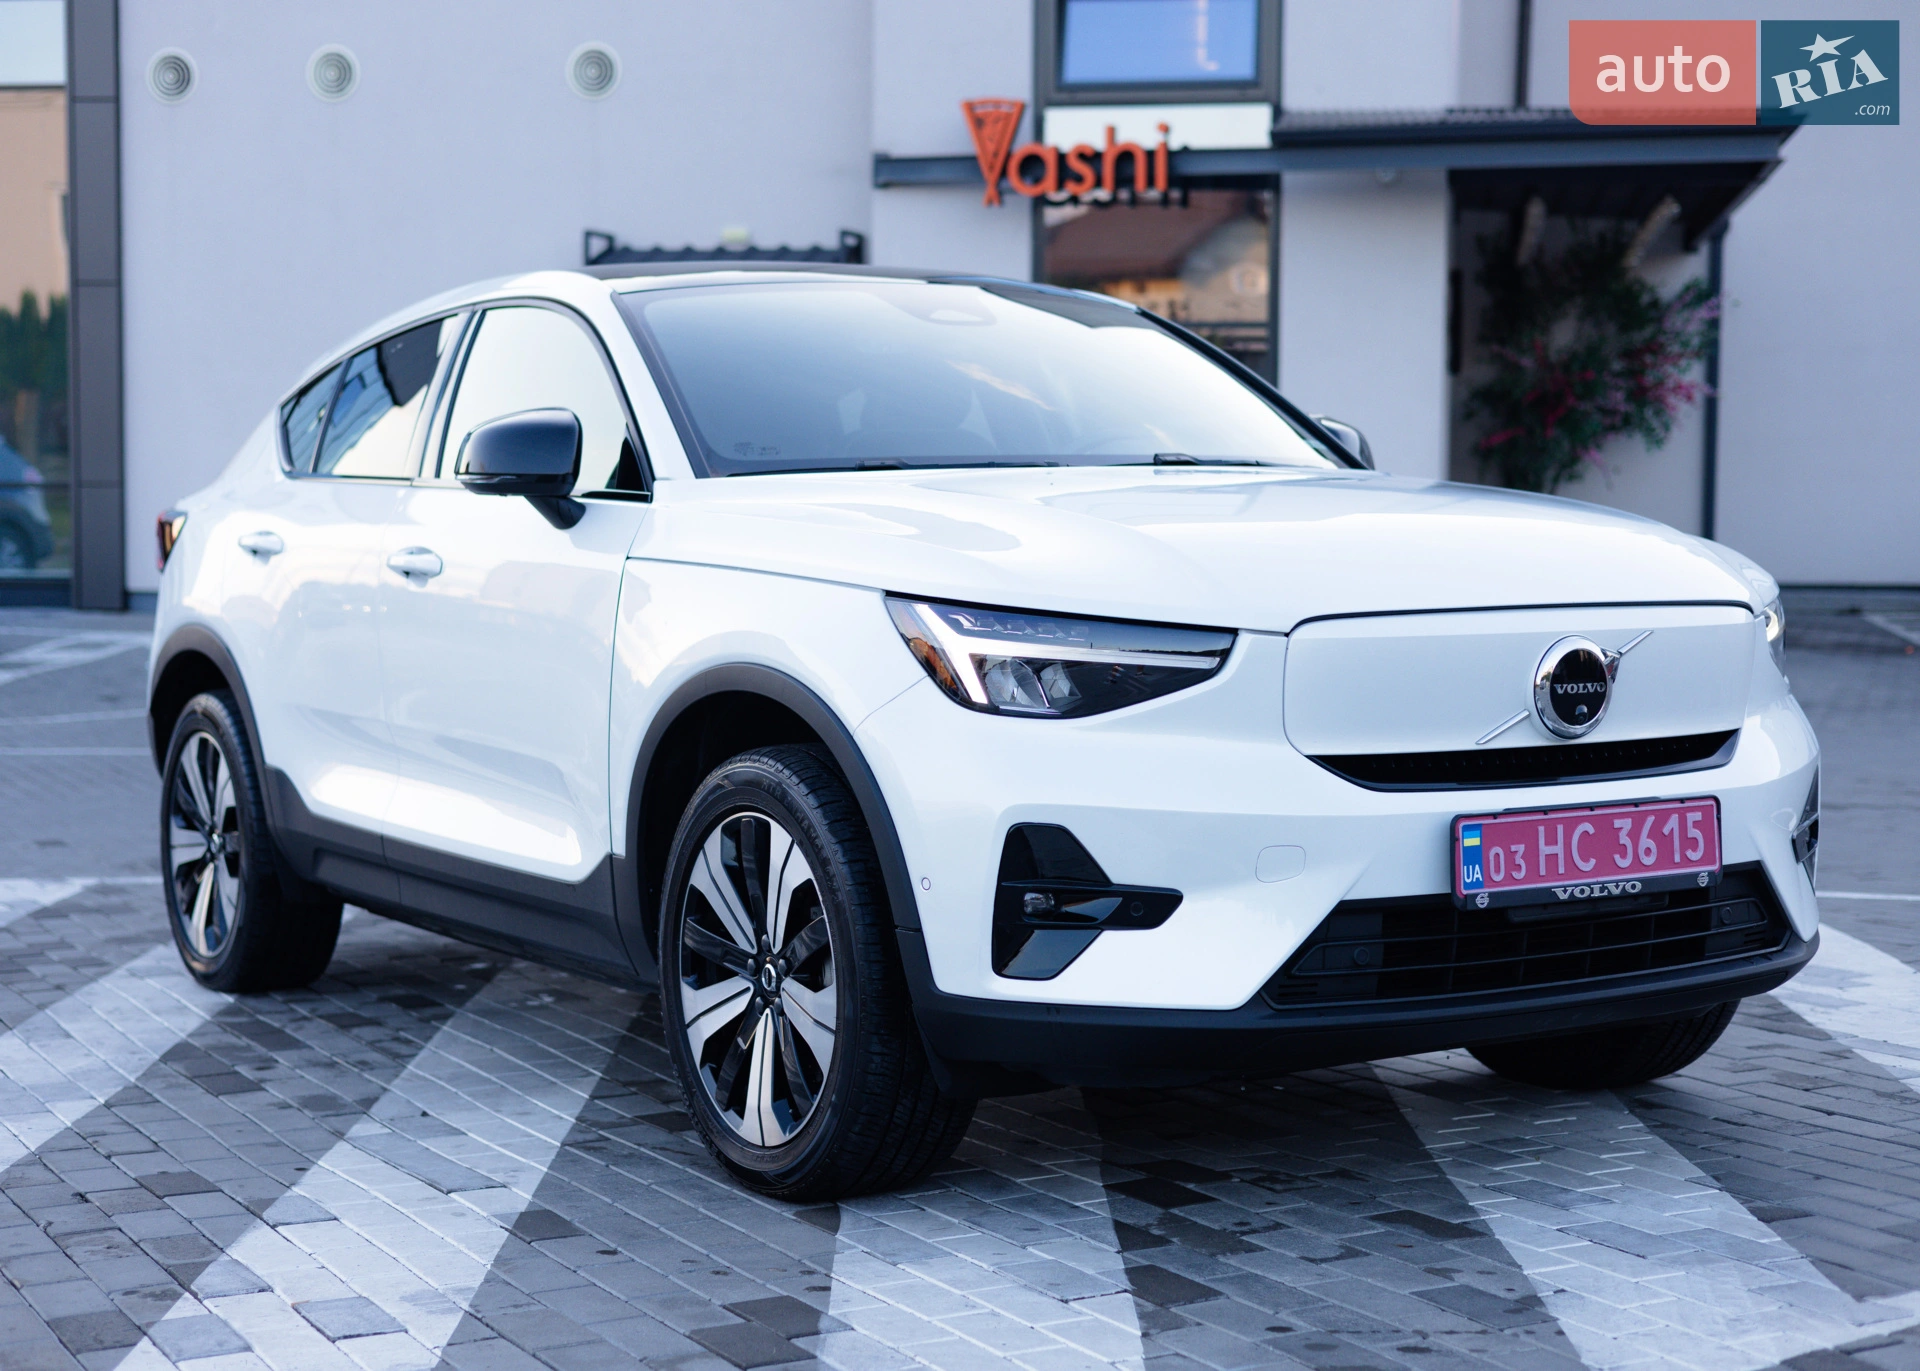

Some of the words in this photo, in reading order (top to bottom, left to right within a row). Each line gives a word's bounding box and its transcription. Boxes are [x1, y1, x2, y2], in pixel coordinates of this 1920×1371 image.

[1553, 681, 1607, 695] VOLVO
[1488, 843, 1527, 882] 03
[1537, 821, 1597, 877] HC
[1612, 810, 1705, 869] 3615
[1463, 863, 1482, 883] UA
[1551, 880, 1642, 900] VOLVO
